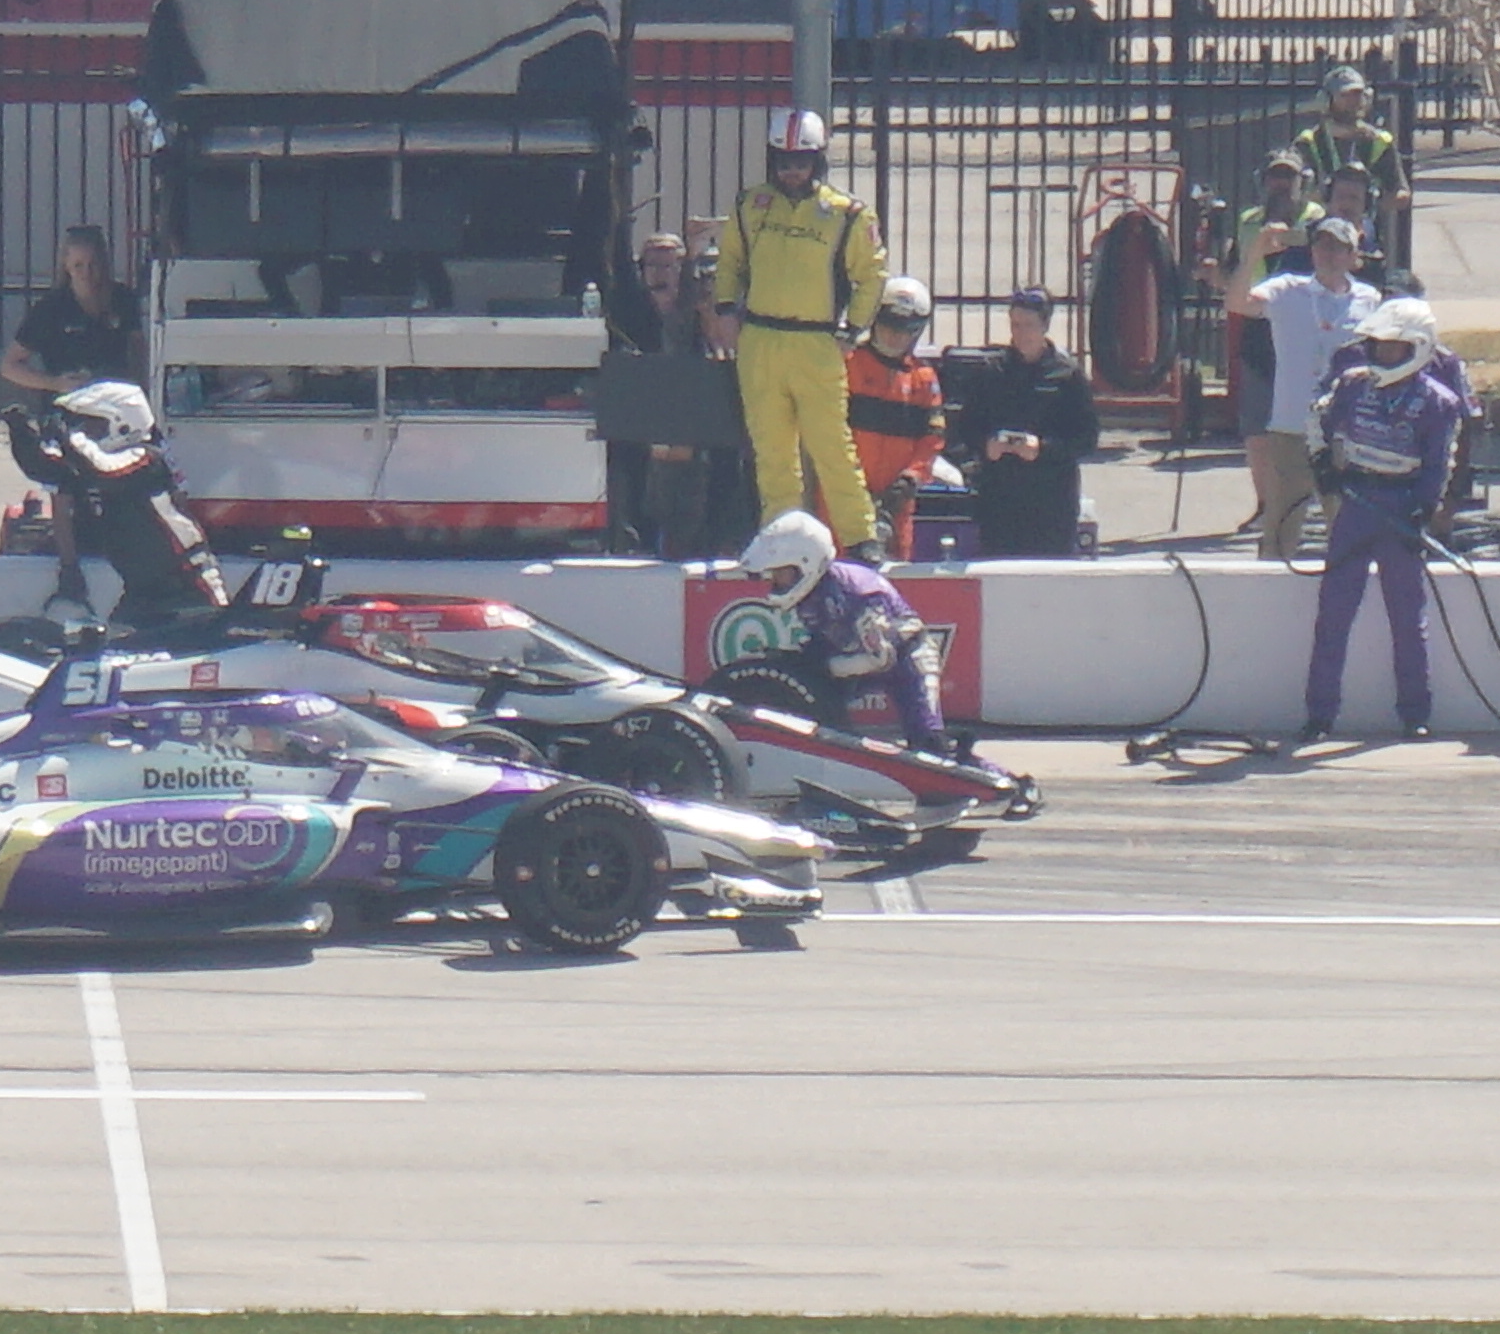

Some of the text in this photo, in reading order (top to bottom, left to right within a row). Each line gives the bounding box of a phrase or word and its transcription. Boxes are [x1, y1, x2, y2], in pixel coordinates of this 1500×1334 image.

[251, 562, 303, 606] 18
[62, 660, 113, 706] 51
[83, 818, 283, 850] Nurtec ODT
[82, 848, 230, 878] (rimegepant)
